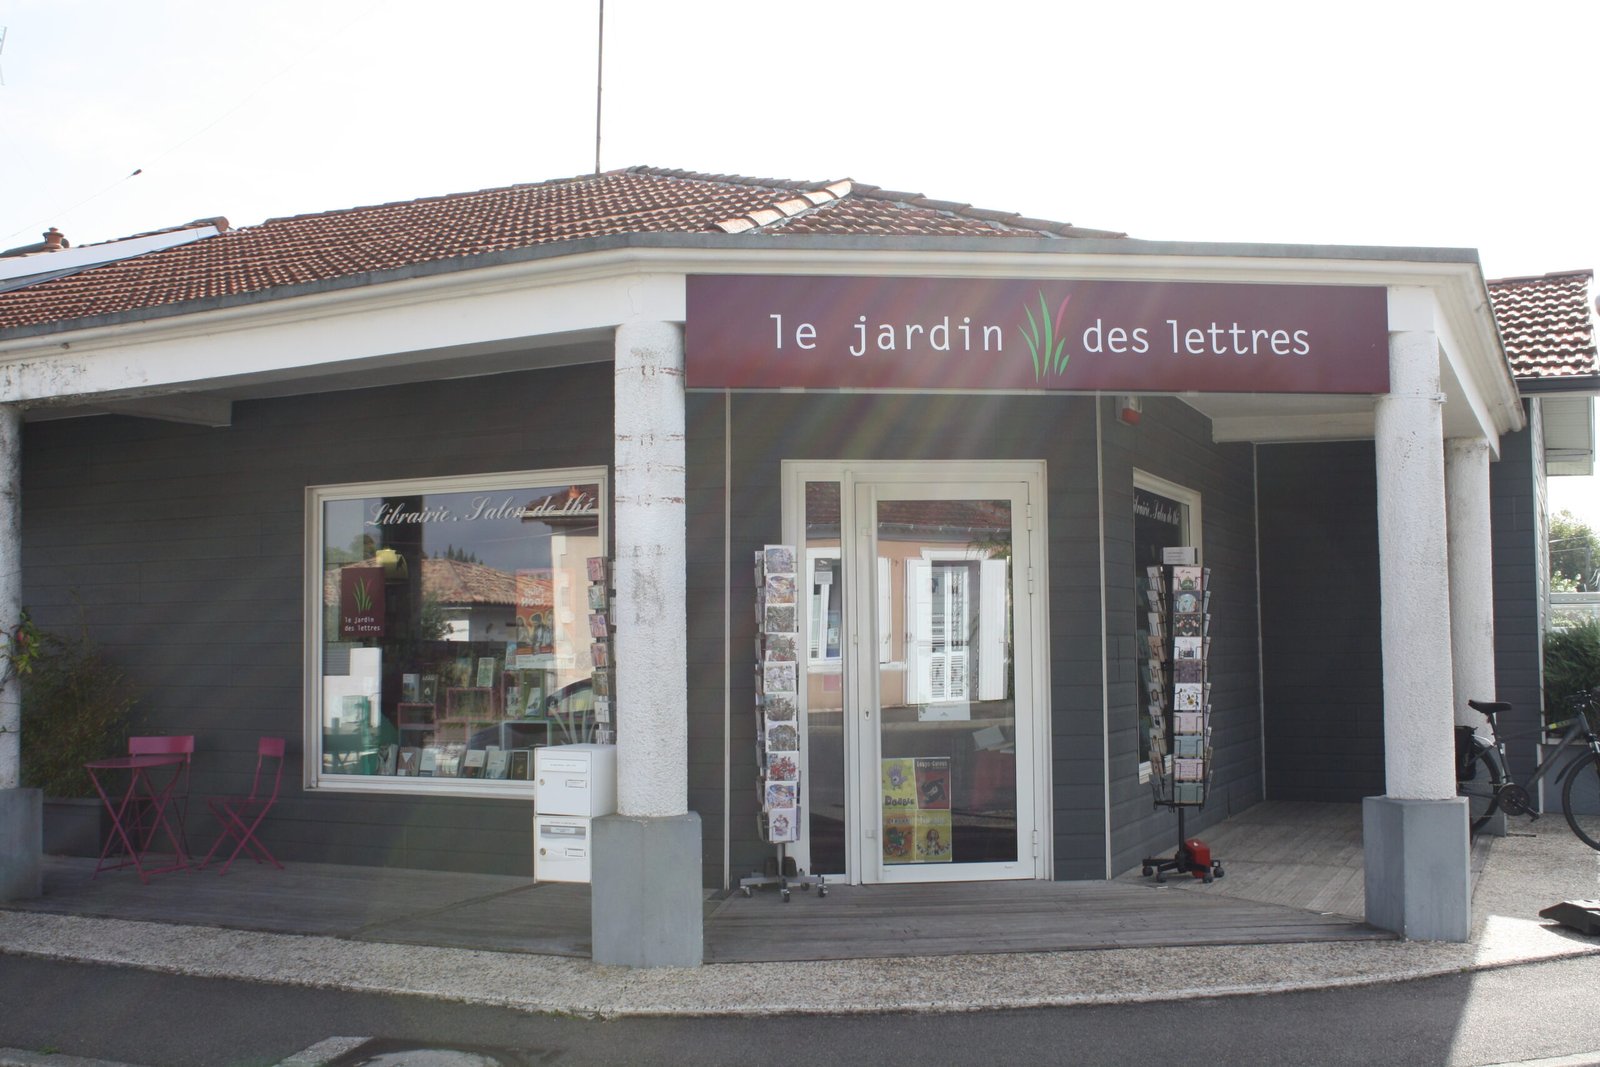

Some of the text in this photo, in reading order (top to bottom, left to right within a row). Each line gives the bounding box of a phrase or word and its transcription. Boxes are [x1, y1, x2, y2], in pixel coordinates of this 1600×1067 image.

[769, 313, 1311, 357] le jardin des lettres
[464, 495, 526, 522] Salon
[530, 495, 561, 518] de
[562, 492, 595, 517] thé
[354, 616, 375, 624] jardin
